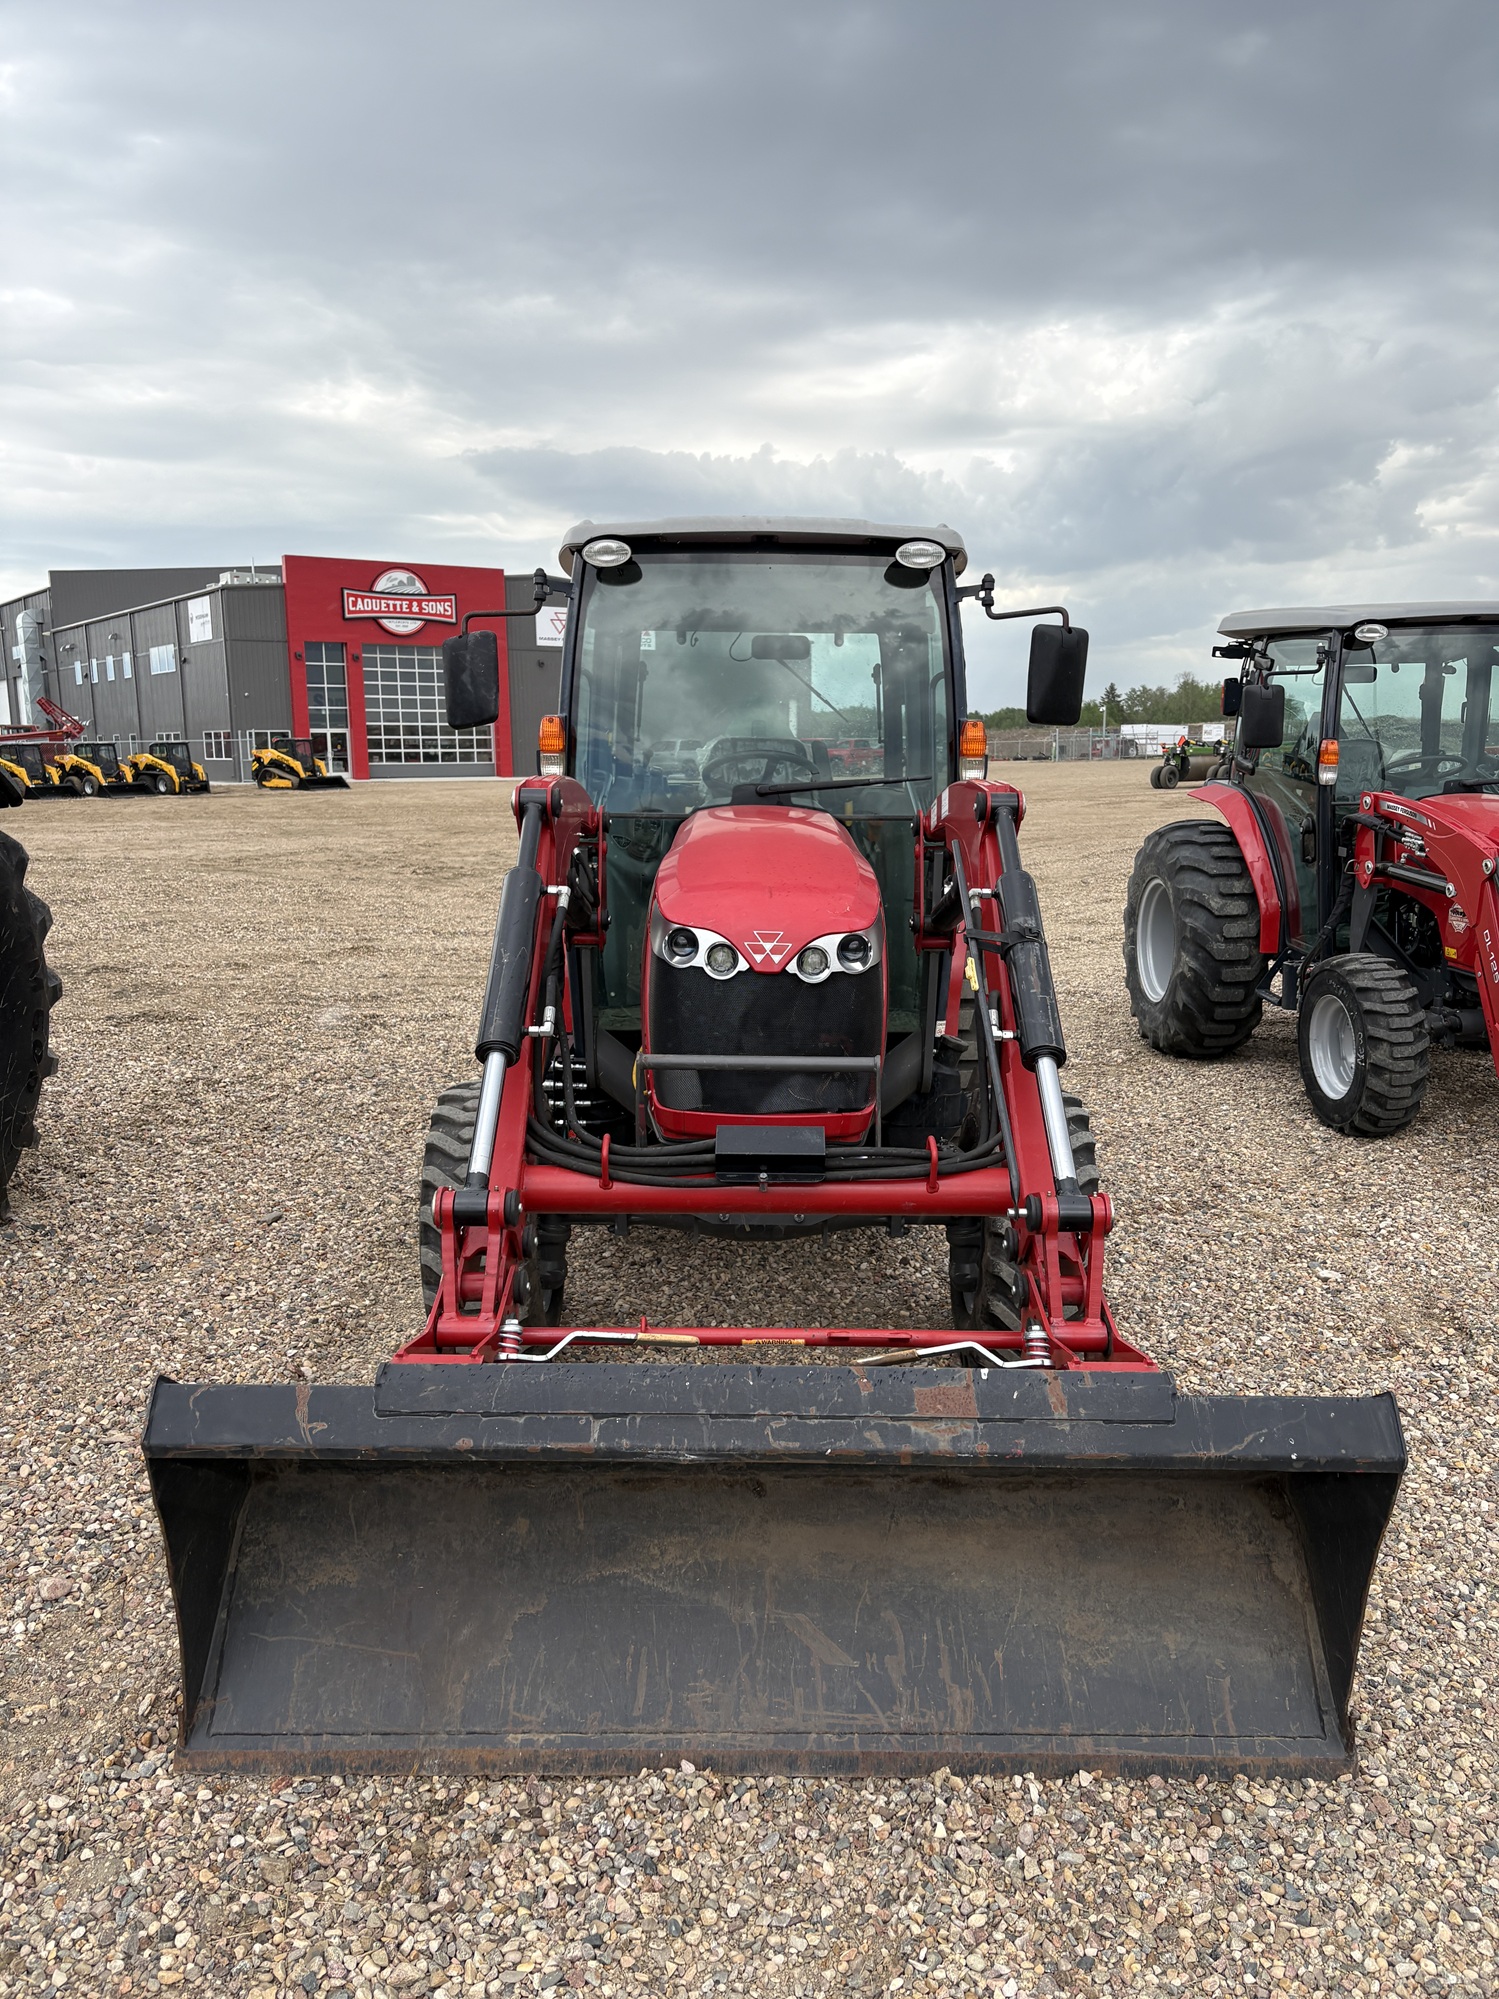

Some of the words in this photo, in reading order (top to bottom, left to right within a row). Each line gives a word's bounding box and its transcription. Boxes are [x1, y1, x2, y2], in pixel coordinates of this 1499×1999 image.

[348, 597, 409, 612] CAOUETTE
[411, 601, 419, 612] &
[422, 602, 452, 615] SONS
